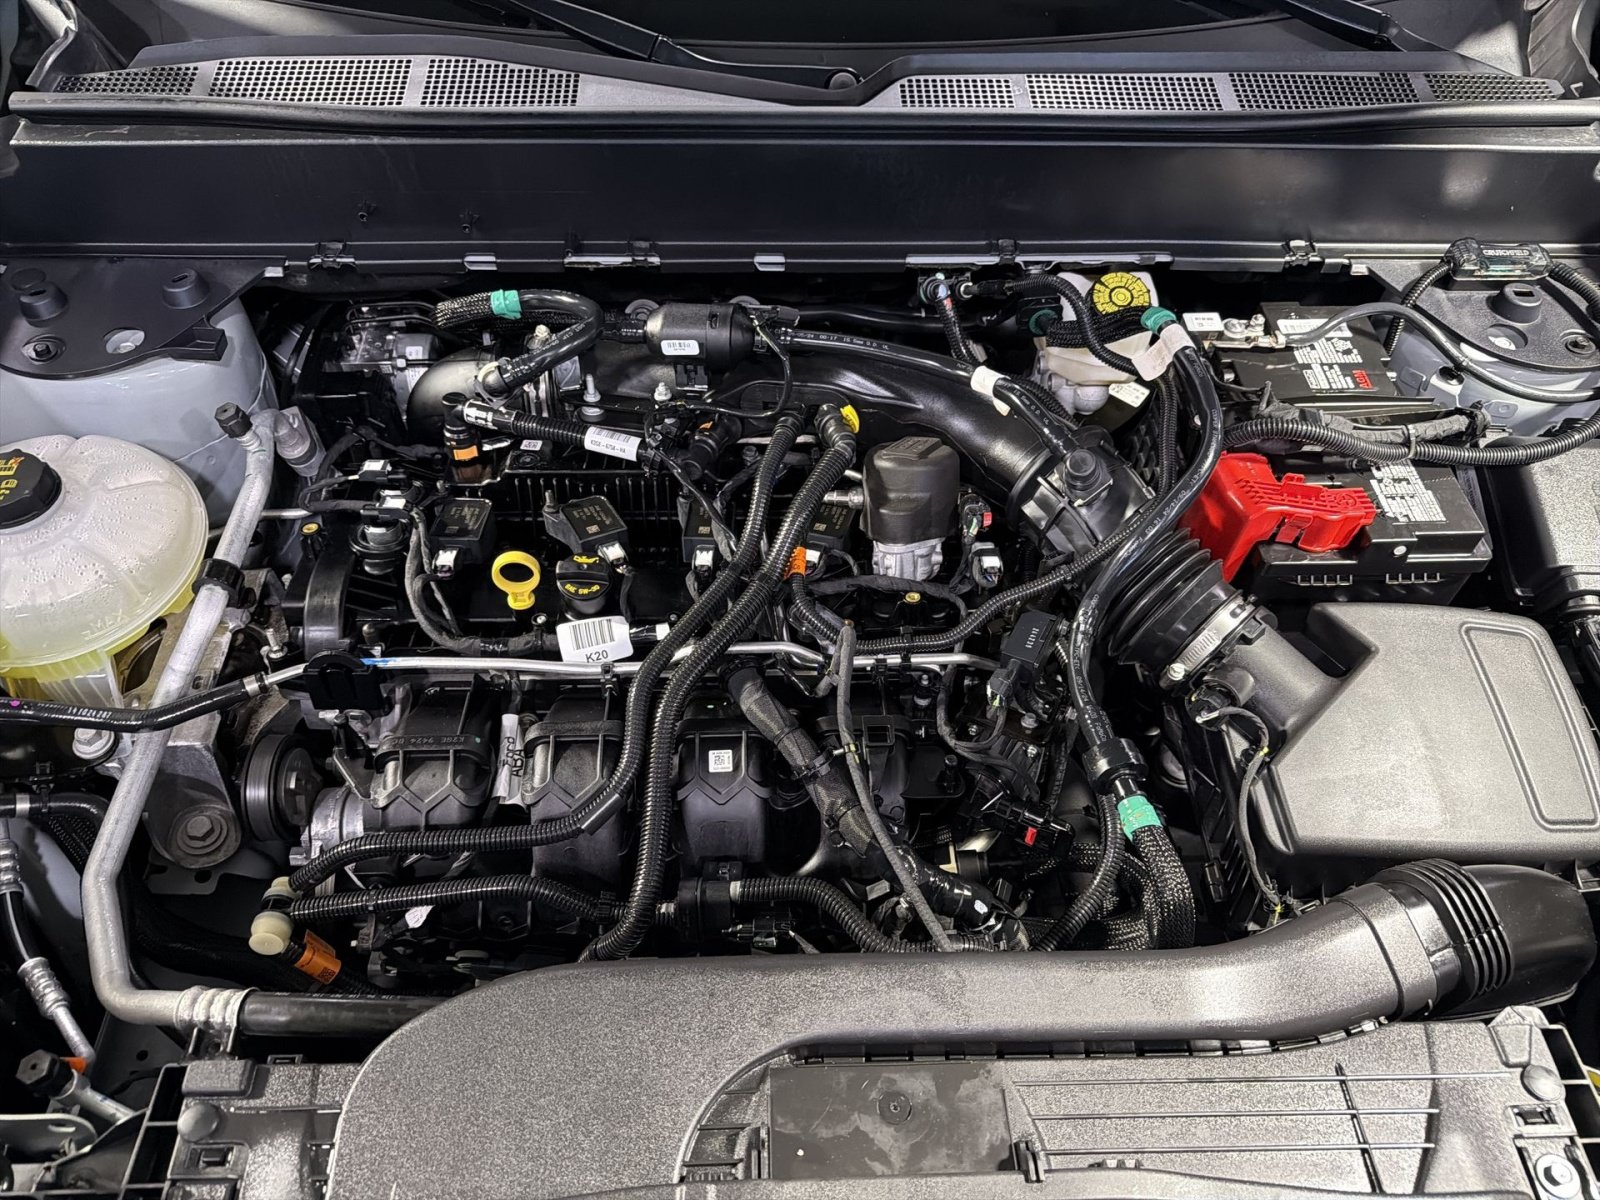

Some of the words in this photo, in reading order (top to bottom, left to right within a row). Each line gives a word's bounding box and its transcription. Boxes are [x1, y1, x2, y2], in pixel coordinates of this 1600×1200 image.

[1352, 369, 1373, 389] AGM
[564, 583, 578, 594] SAE
[585, 649, 609, 664] K20
